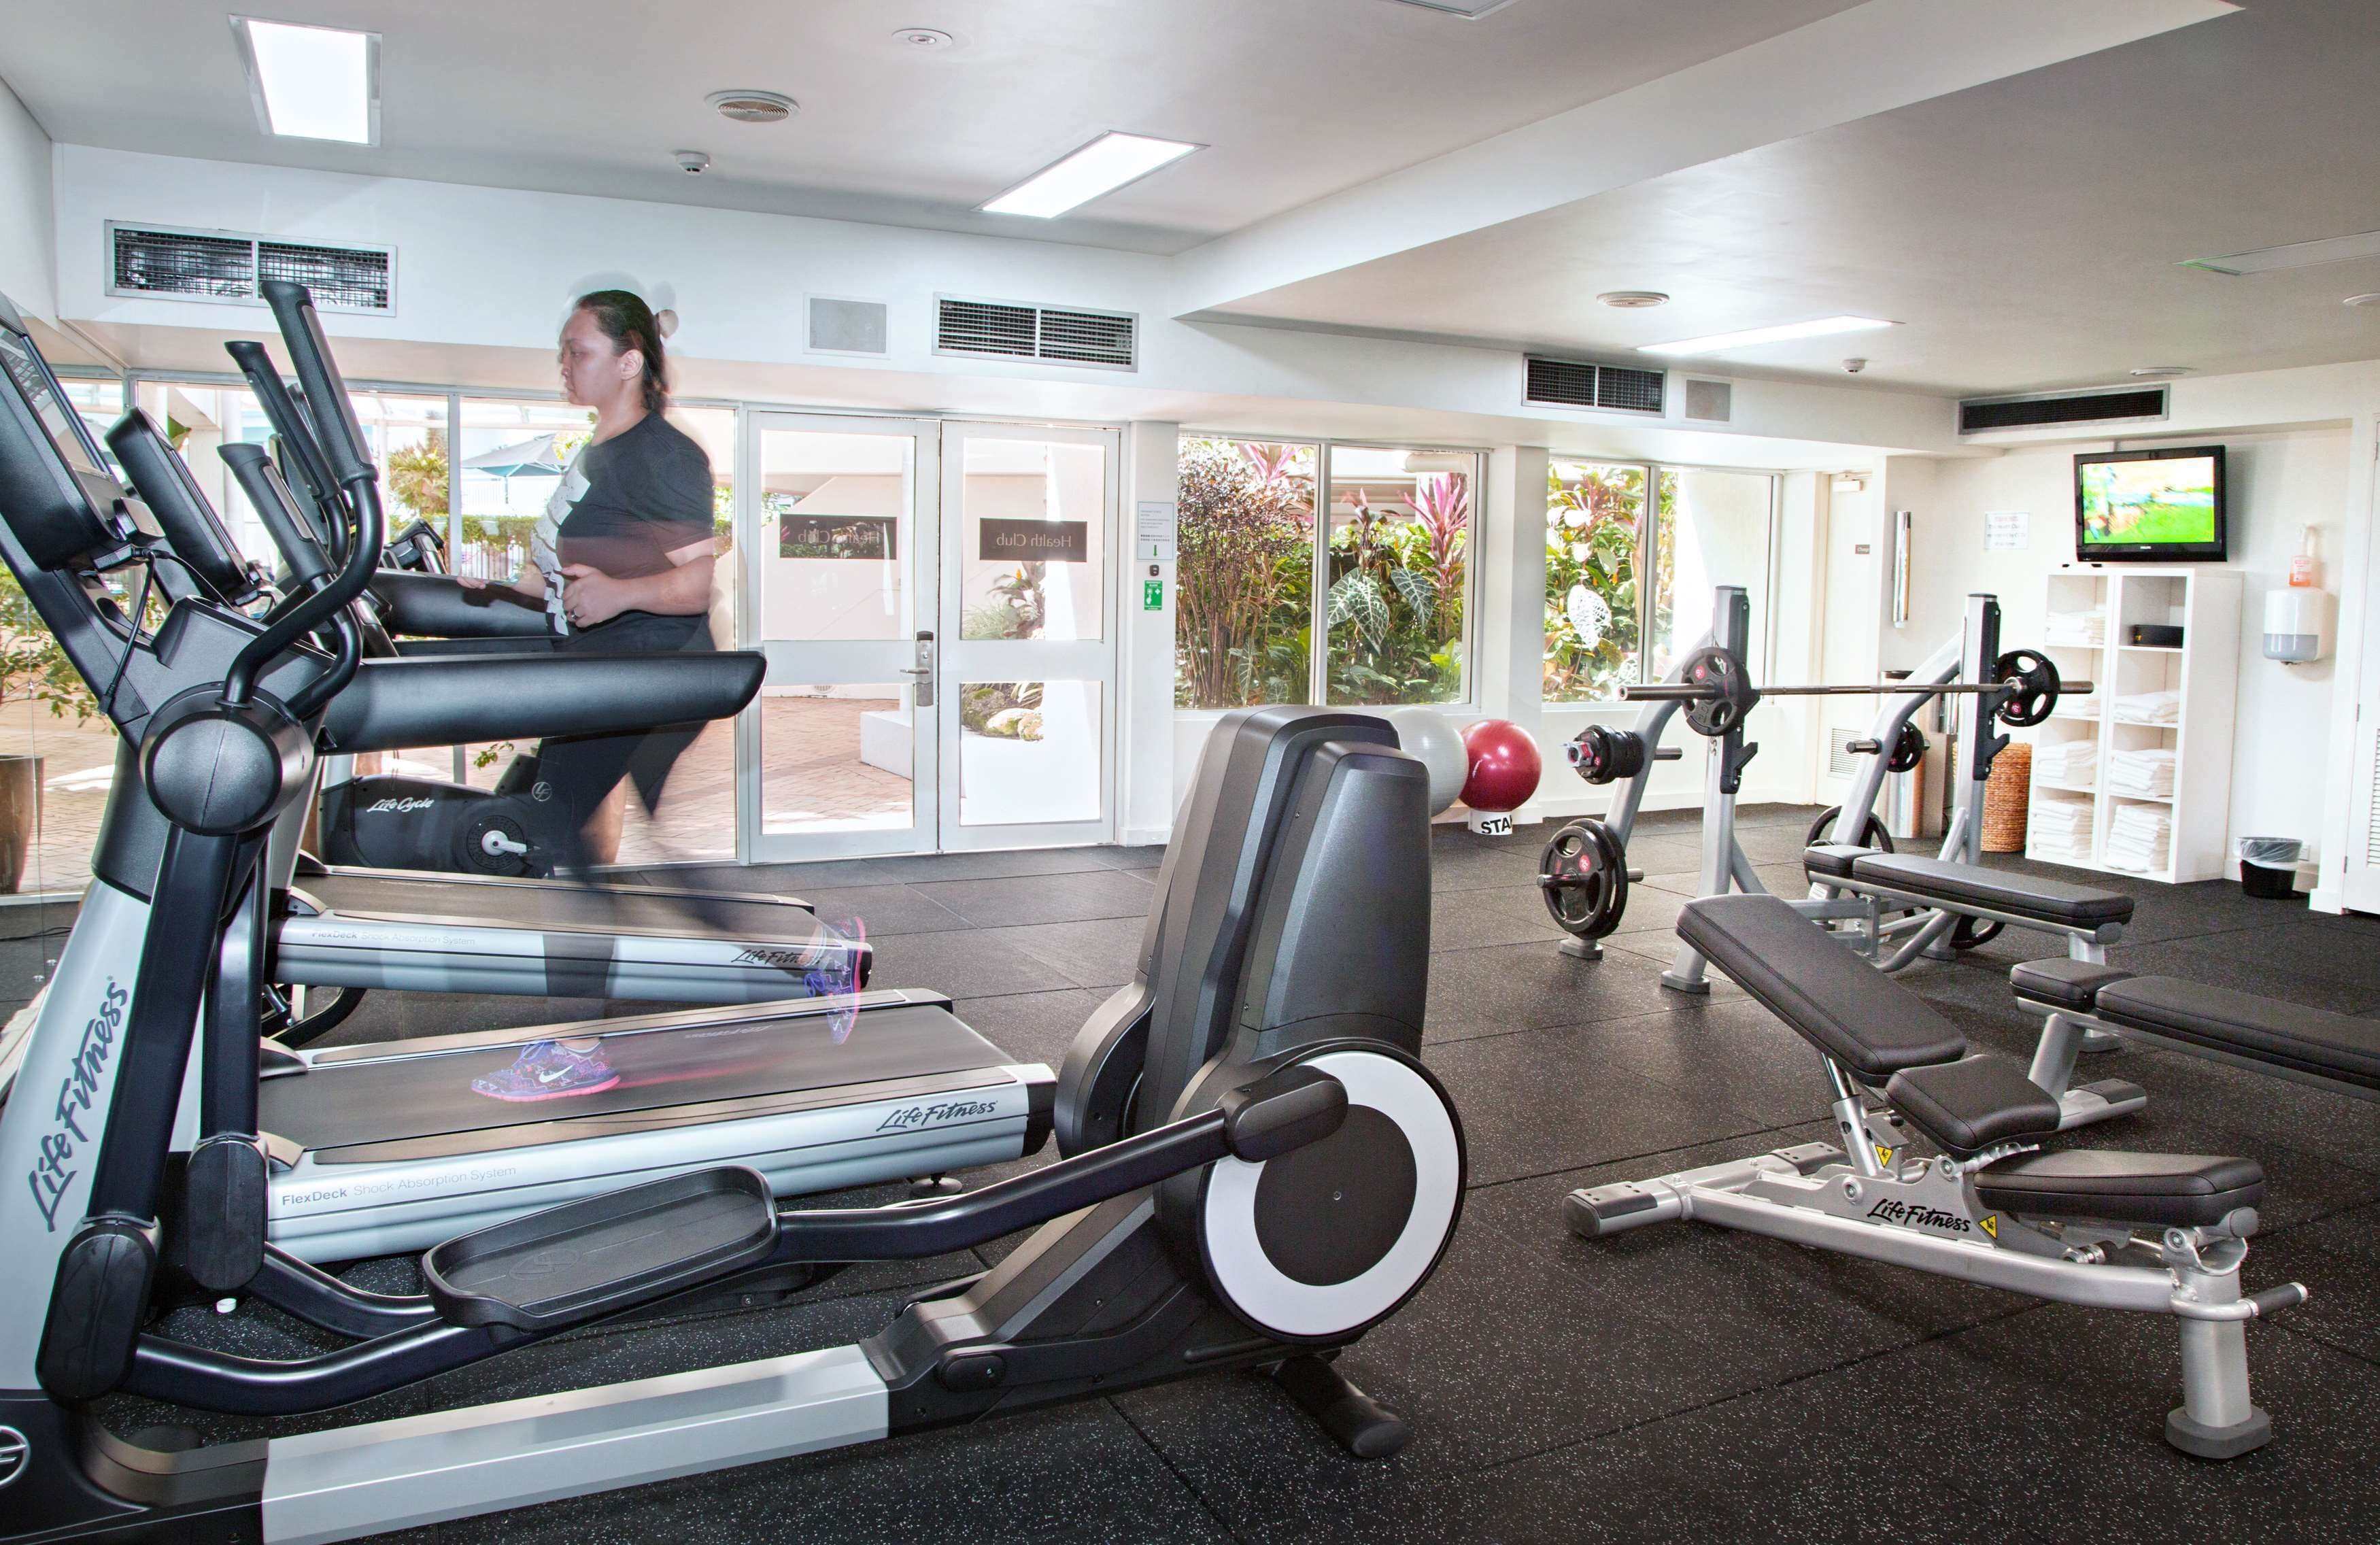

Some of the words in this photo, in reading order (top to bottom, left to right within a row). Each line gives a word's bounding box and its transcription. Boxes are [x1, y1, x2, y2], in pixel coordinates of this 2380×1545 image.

[1481, 815, 1512, 834] STA
[442, 935, 475, 945] System
[764, 951, 821, 965] Fitn
[282, 1188, 347, 1206] FlexDeck
[354, 1183, 394, 1196] Shock
[398, 1172, 467, 1190] Absorption
[471, 1166, 517, 1182] System
